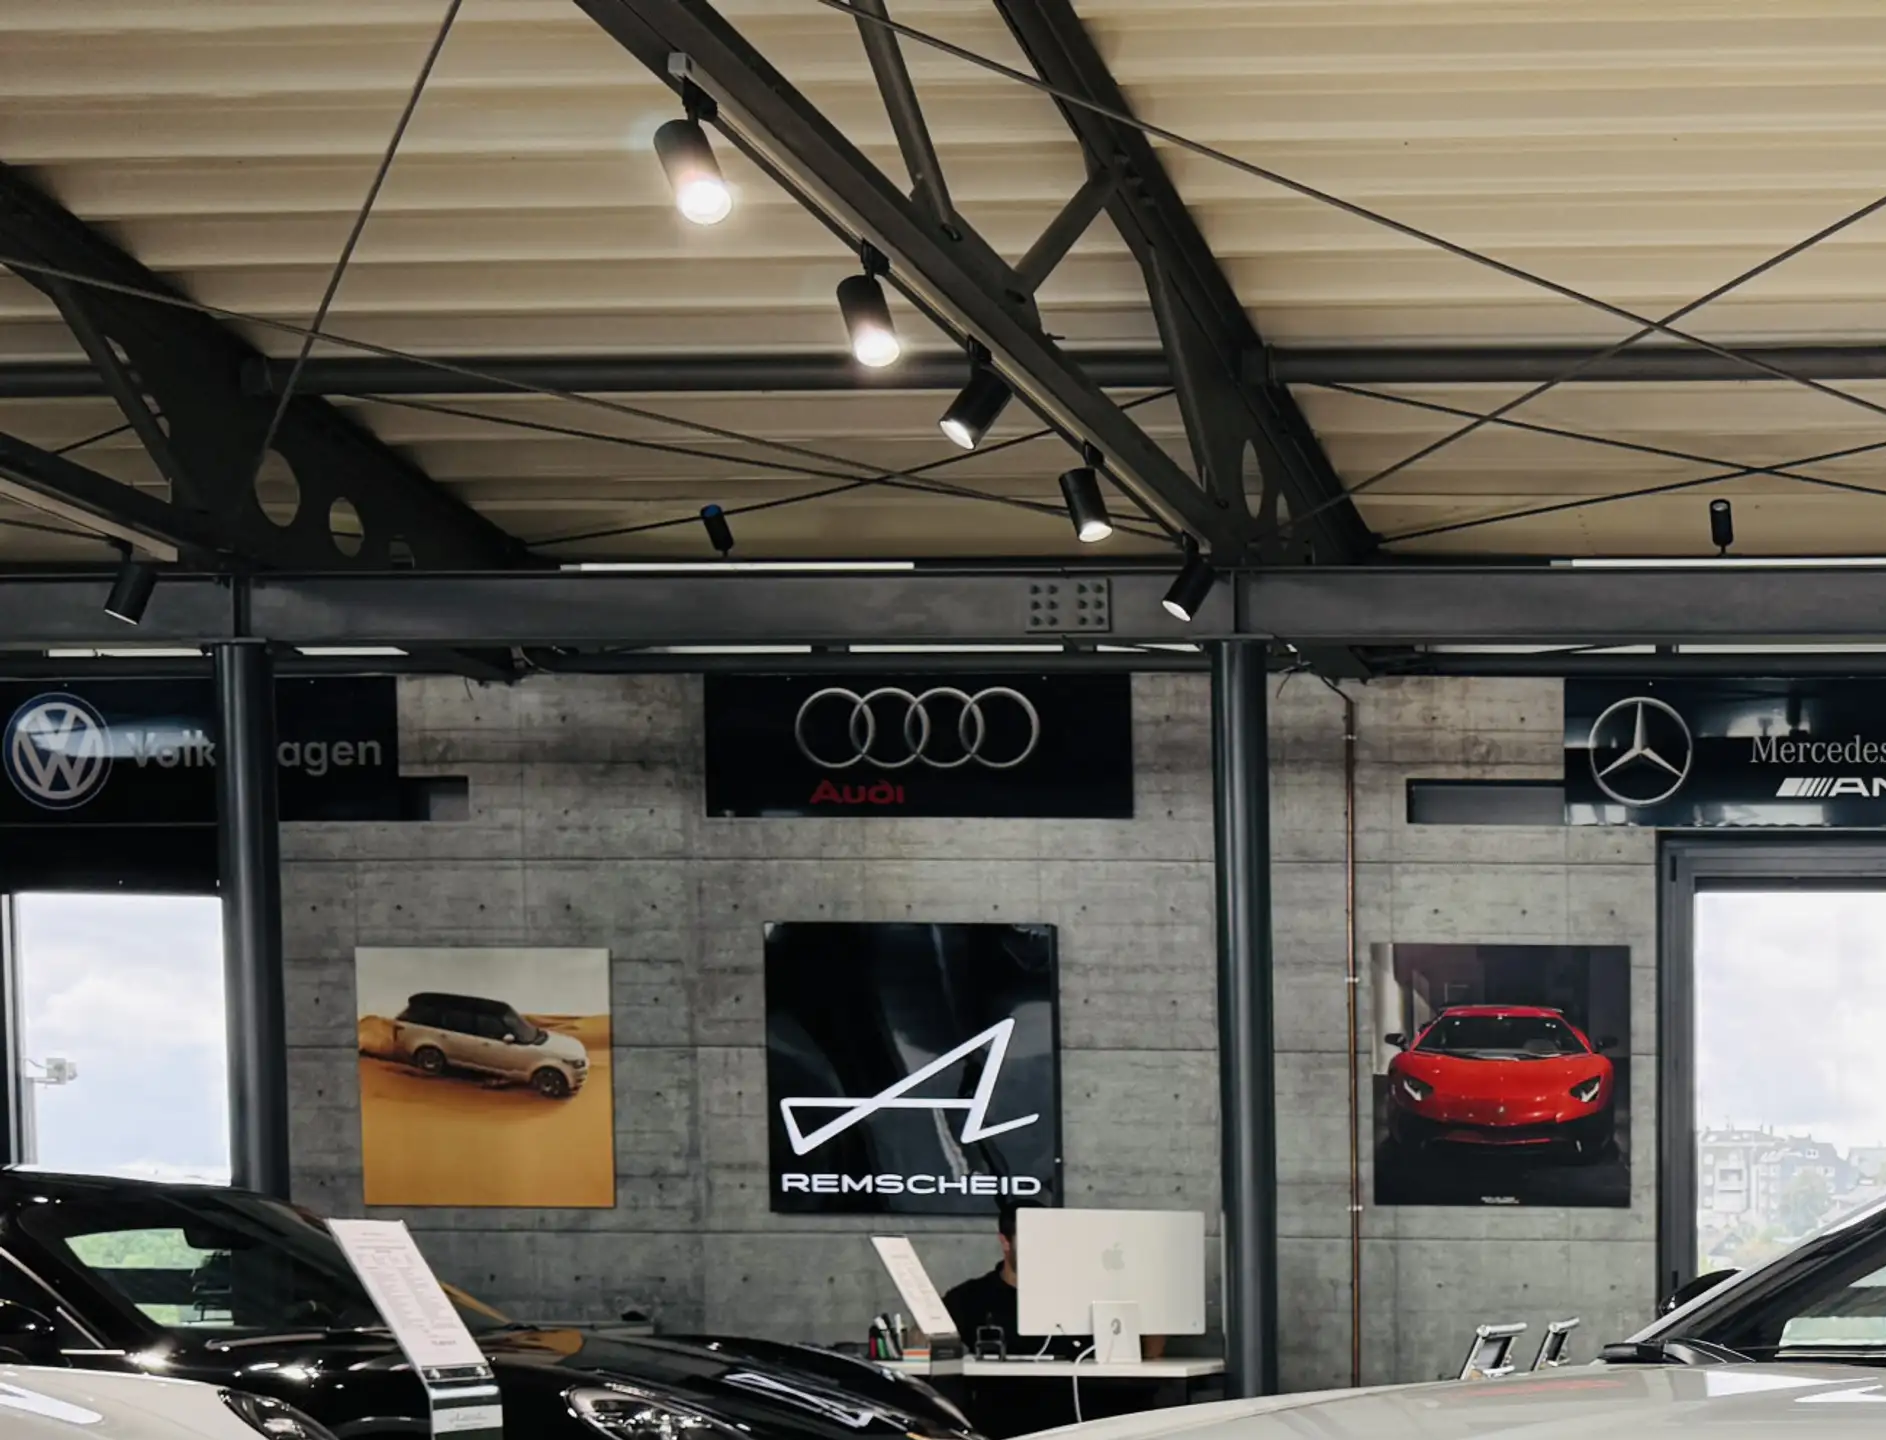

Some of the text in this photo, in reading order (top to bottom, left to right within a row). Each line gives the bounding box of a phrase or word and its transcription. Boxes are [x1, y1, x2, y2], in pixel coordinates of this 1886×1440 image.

[126, 729, 383, 776] Volkagen
[809, 780, 905, 804] Audi
[781, 1173, 1042, 1196] REMSCHEID
